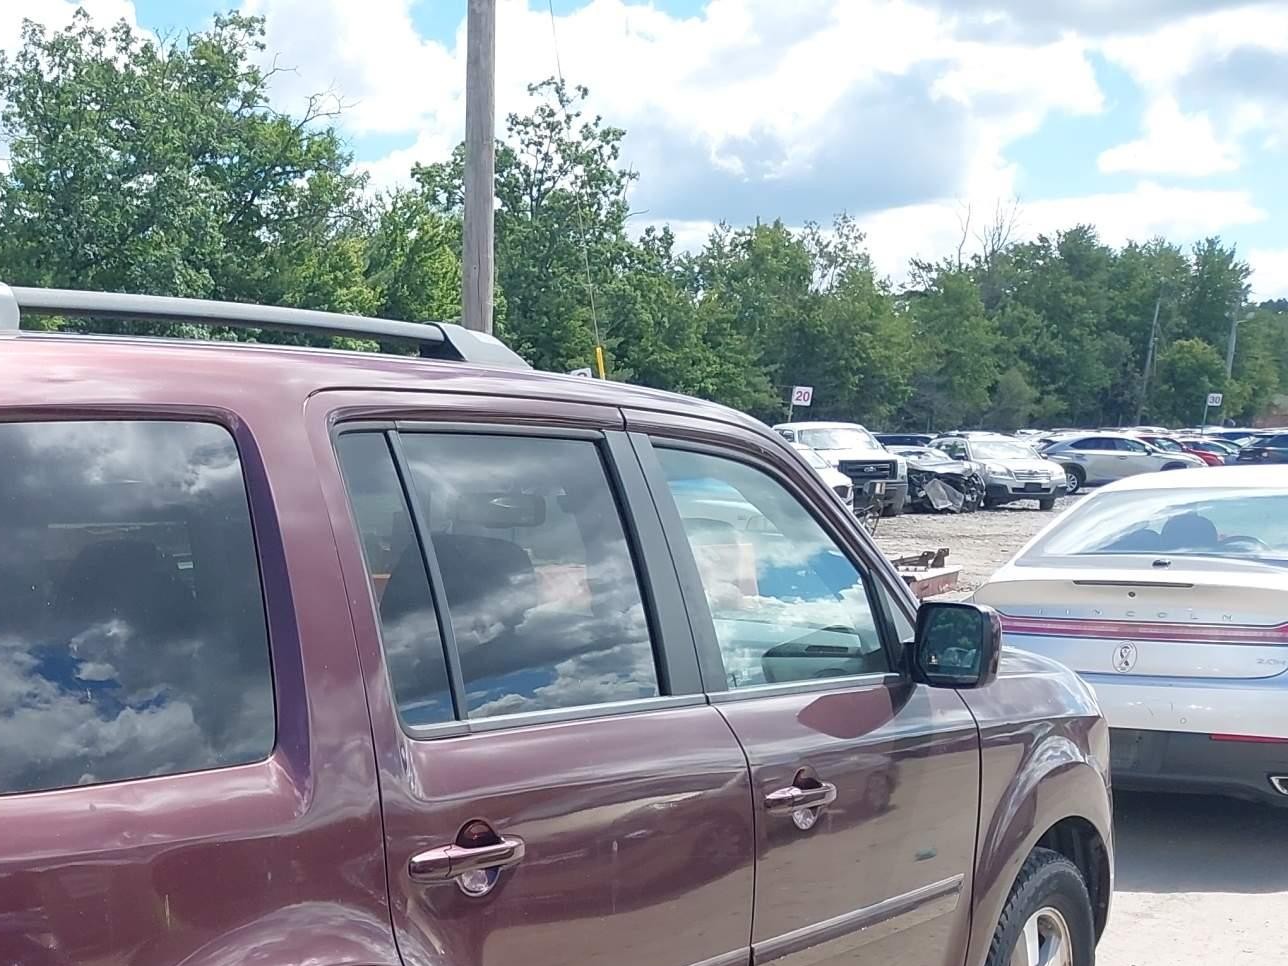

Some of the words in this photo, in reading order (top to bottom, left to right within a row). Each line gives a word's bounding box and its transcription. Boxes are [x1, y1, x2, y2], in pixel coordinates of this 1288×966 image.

[795, 390, 810, 402] 20
[1208, 396, 1221, 404] 30
[1037, 607, 1233, 622] LINCOLN
